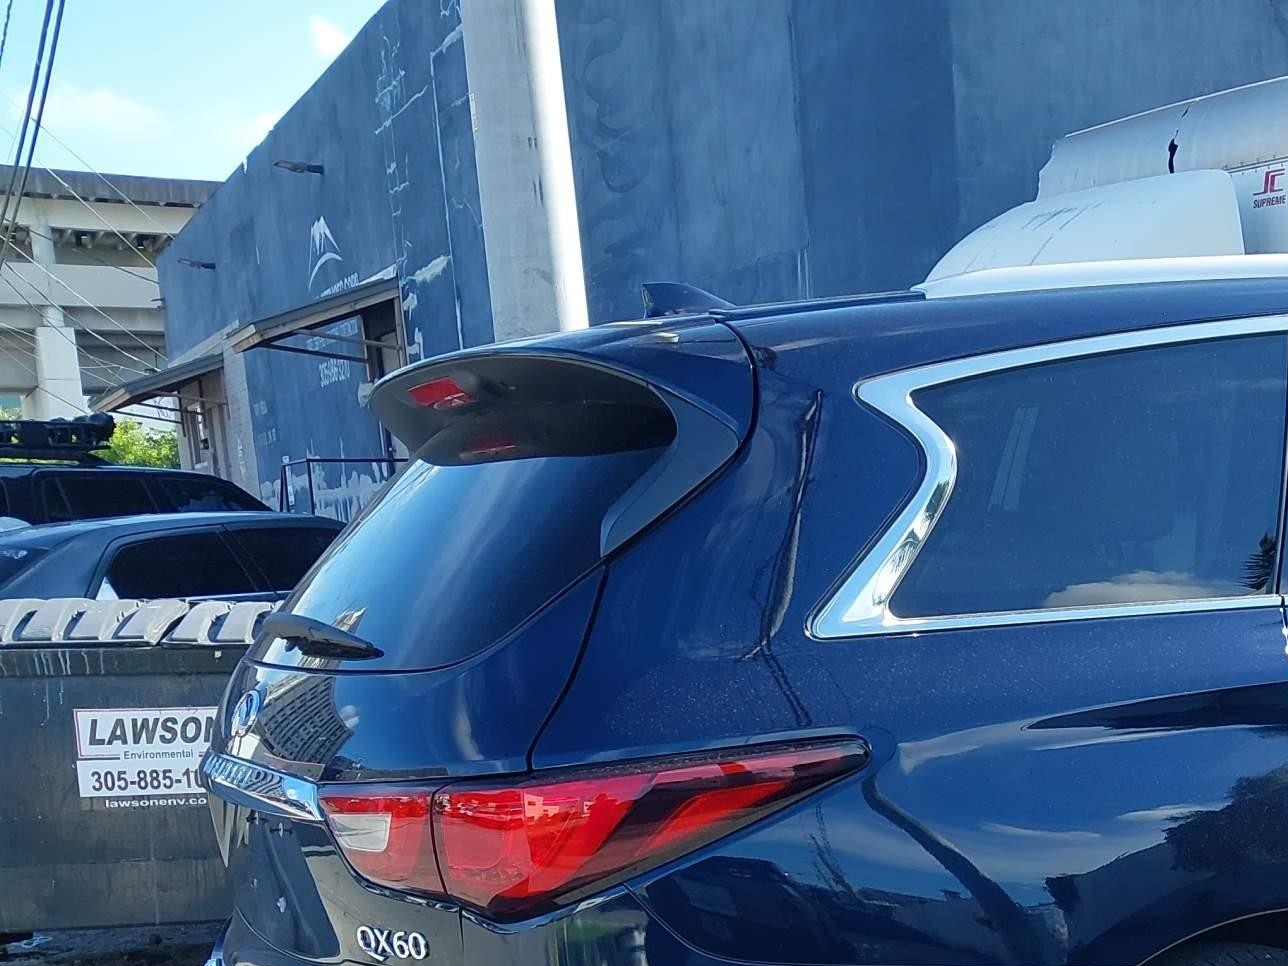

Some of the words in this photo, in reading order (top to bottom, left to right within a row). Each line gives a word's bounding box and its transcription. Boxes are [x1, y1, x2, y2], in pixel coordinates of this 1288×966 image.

[1252, 195, 1287, 208] SUPREME
[123, 749, 194, 760] Environmental
[357, 926, 429, 962] QX60
